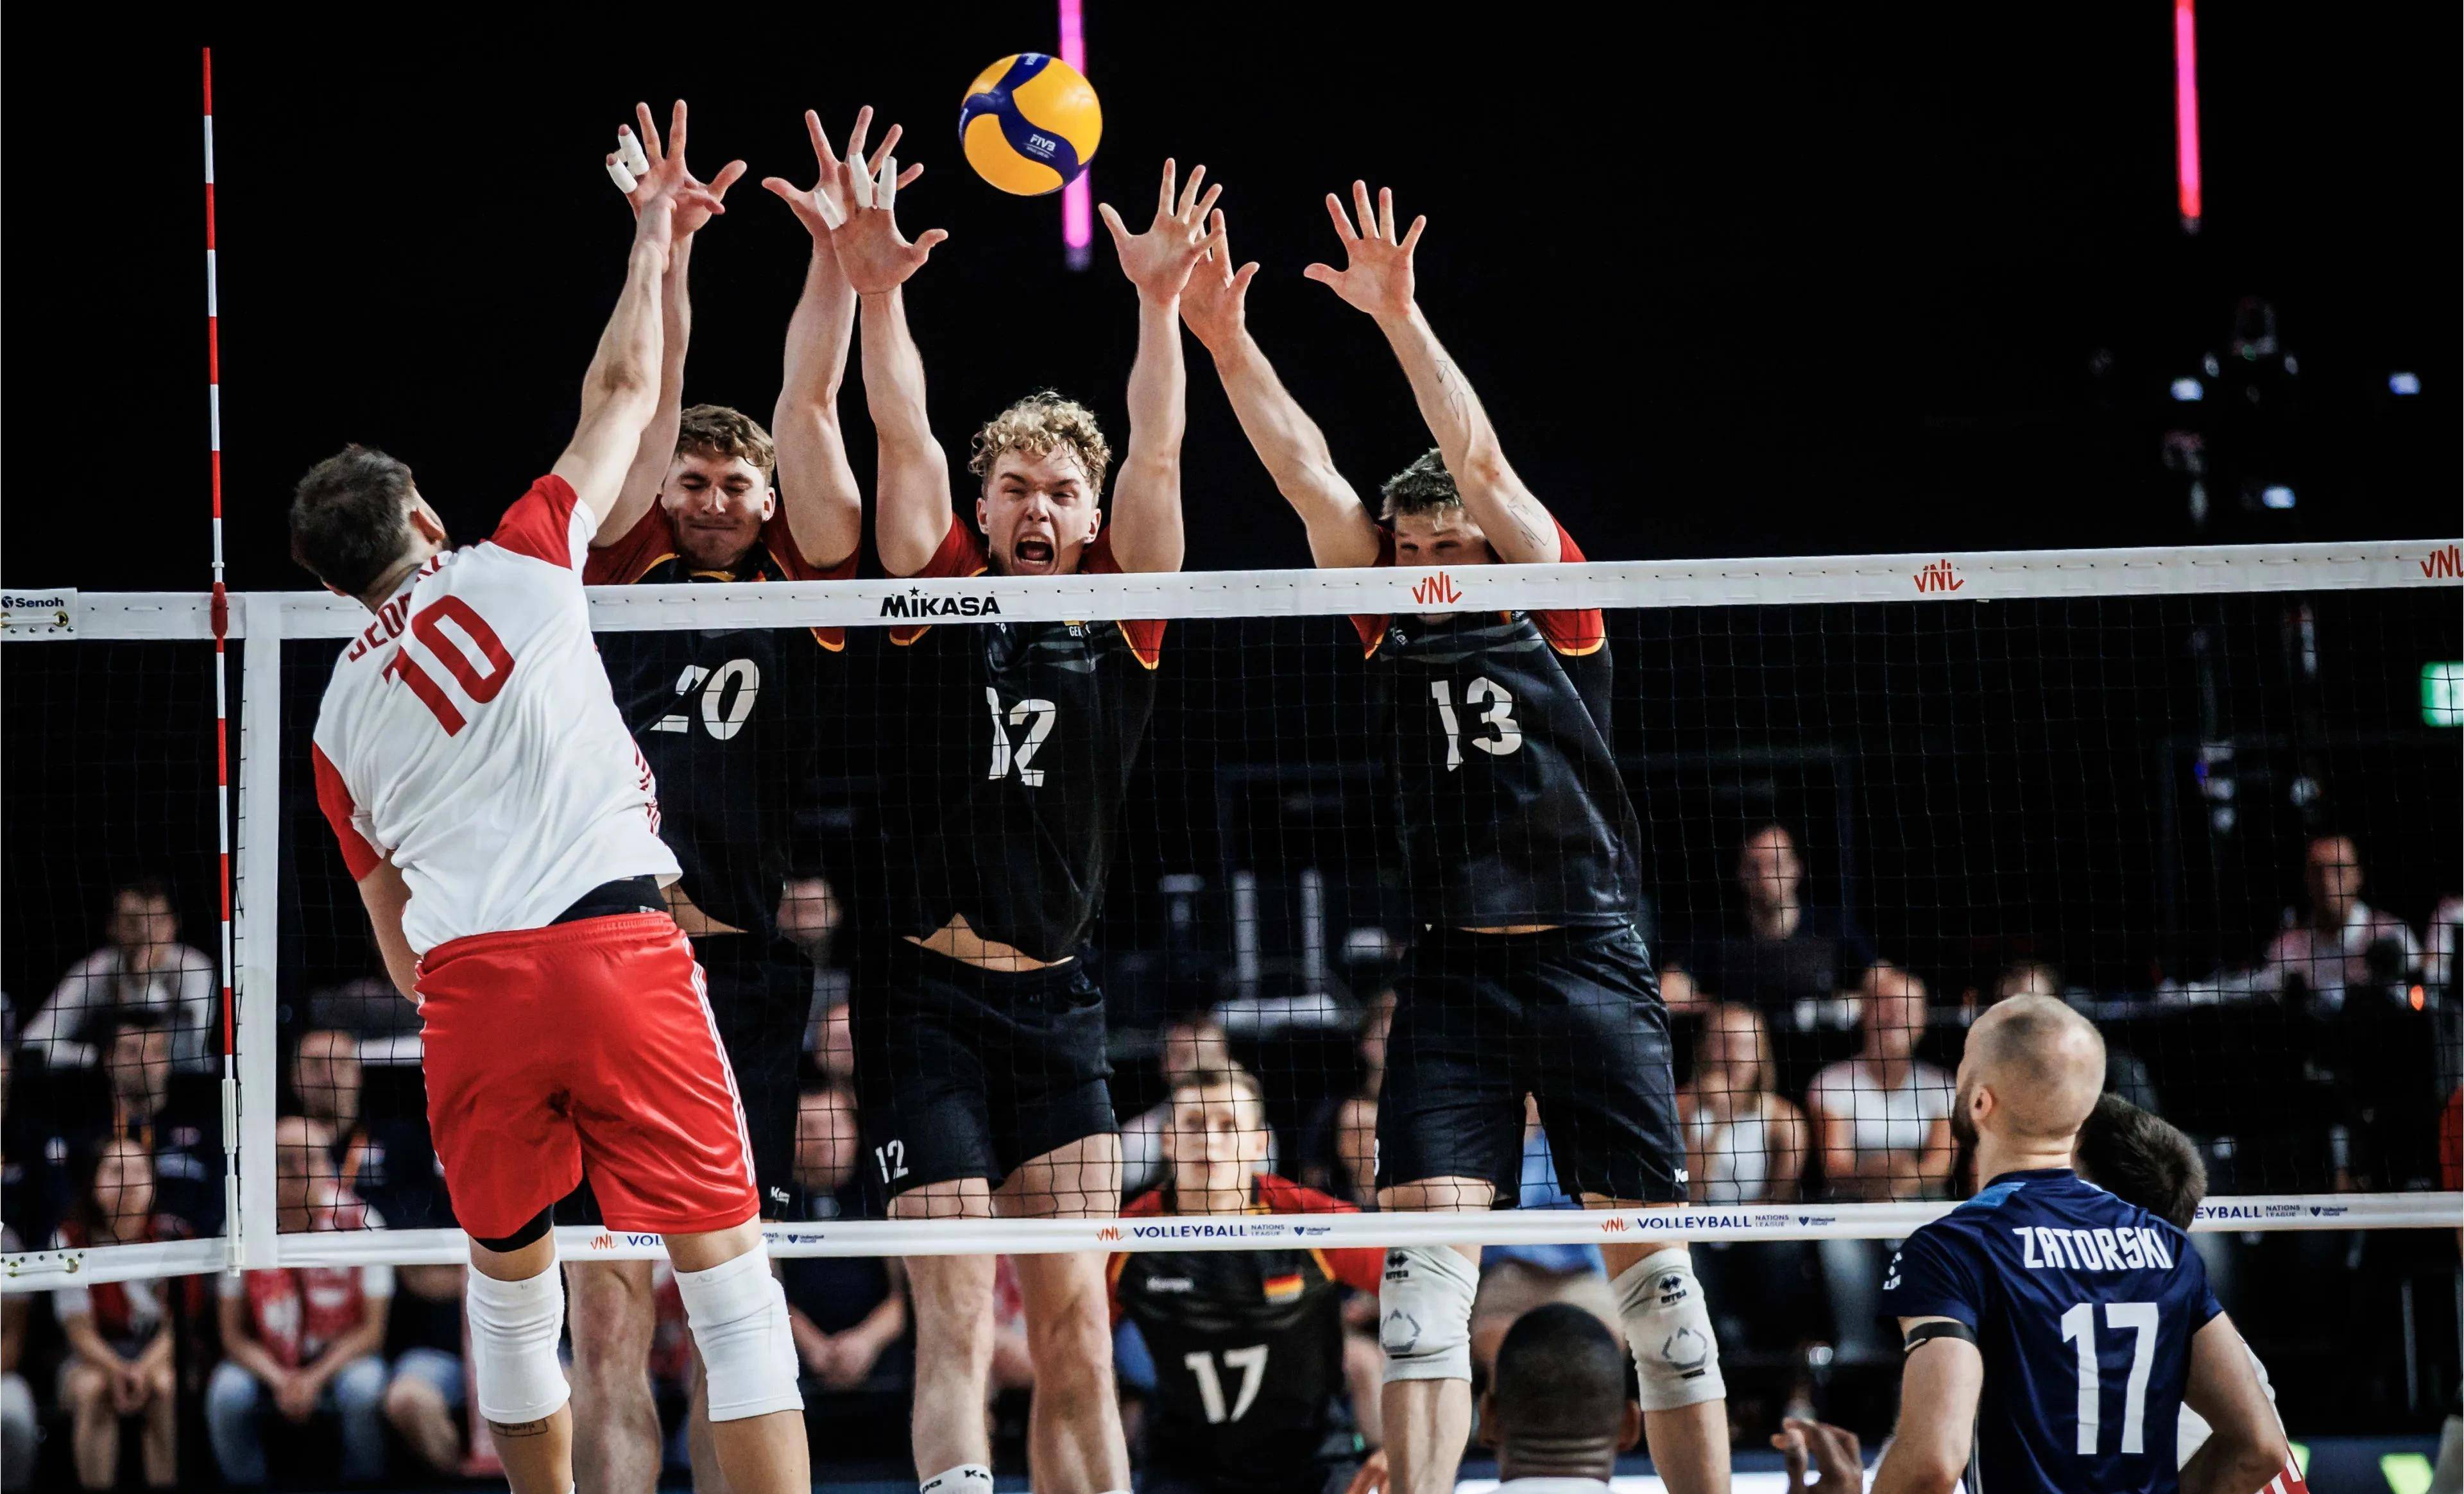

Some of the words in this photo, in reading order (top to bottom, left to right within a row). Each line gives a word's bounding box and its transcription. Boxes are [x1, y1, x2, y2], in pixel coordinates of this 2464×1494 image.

[1412, 571, 1462, 604] VNL
[1913, 559, 1965, 593] VNL
[15, 597, 64, 607] Senoh
[382, 595, 515, 738] 10
[649, 659, 760, 740] 20
[986, 686, 1056, 787] 12
[1431, 677, 1522, 772] 13
[875, 1139, 909, 1184] 12
[1097, 1226, 1124, 1241] VNL
[1134, 1225, 1247, 1238] VOLLEYBALL
[1602, 1217, 1630, 1233] VNL
[1638, 1216, 1752, 1228] VOLLEYBALL
[2194, 1206, 2262, 1219] EYBALL
[590, 1234, 618, 1250] VNL
[627, 1234, 663, 1246] VOL
[2012, 1227, 2174, 1270] ZATORSKI
[1184, 1345, 1269, 1424] 17
[2060, 1302, 2159, 1455] 17
